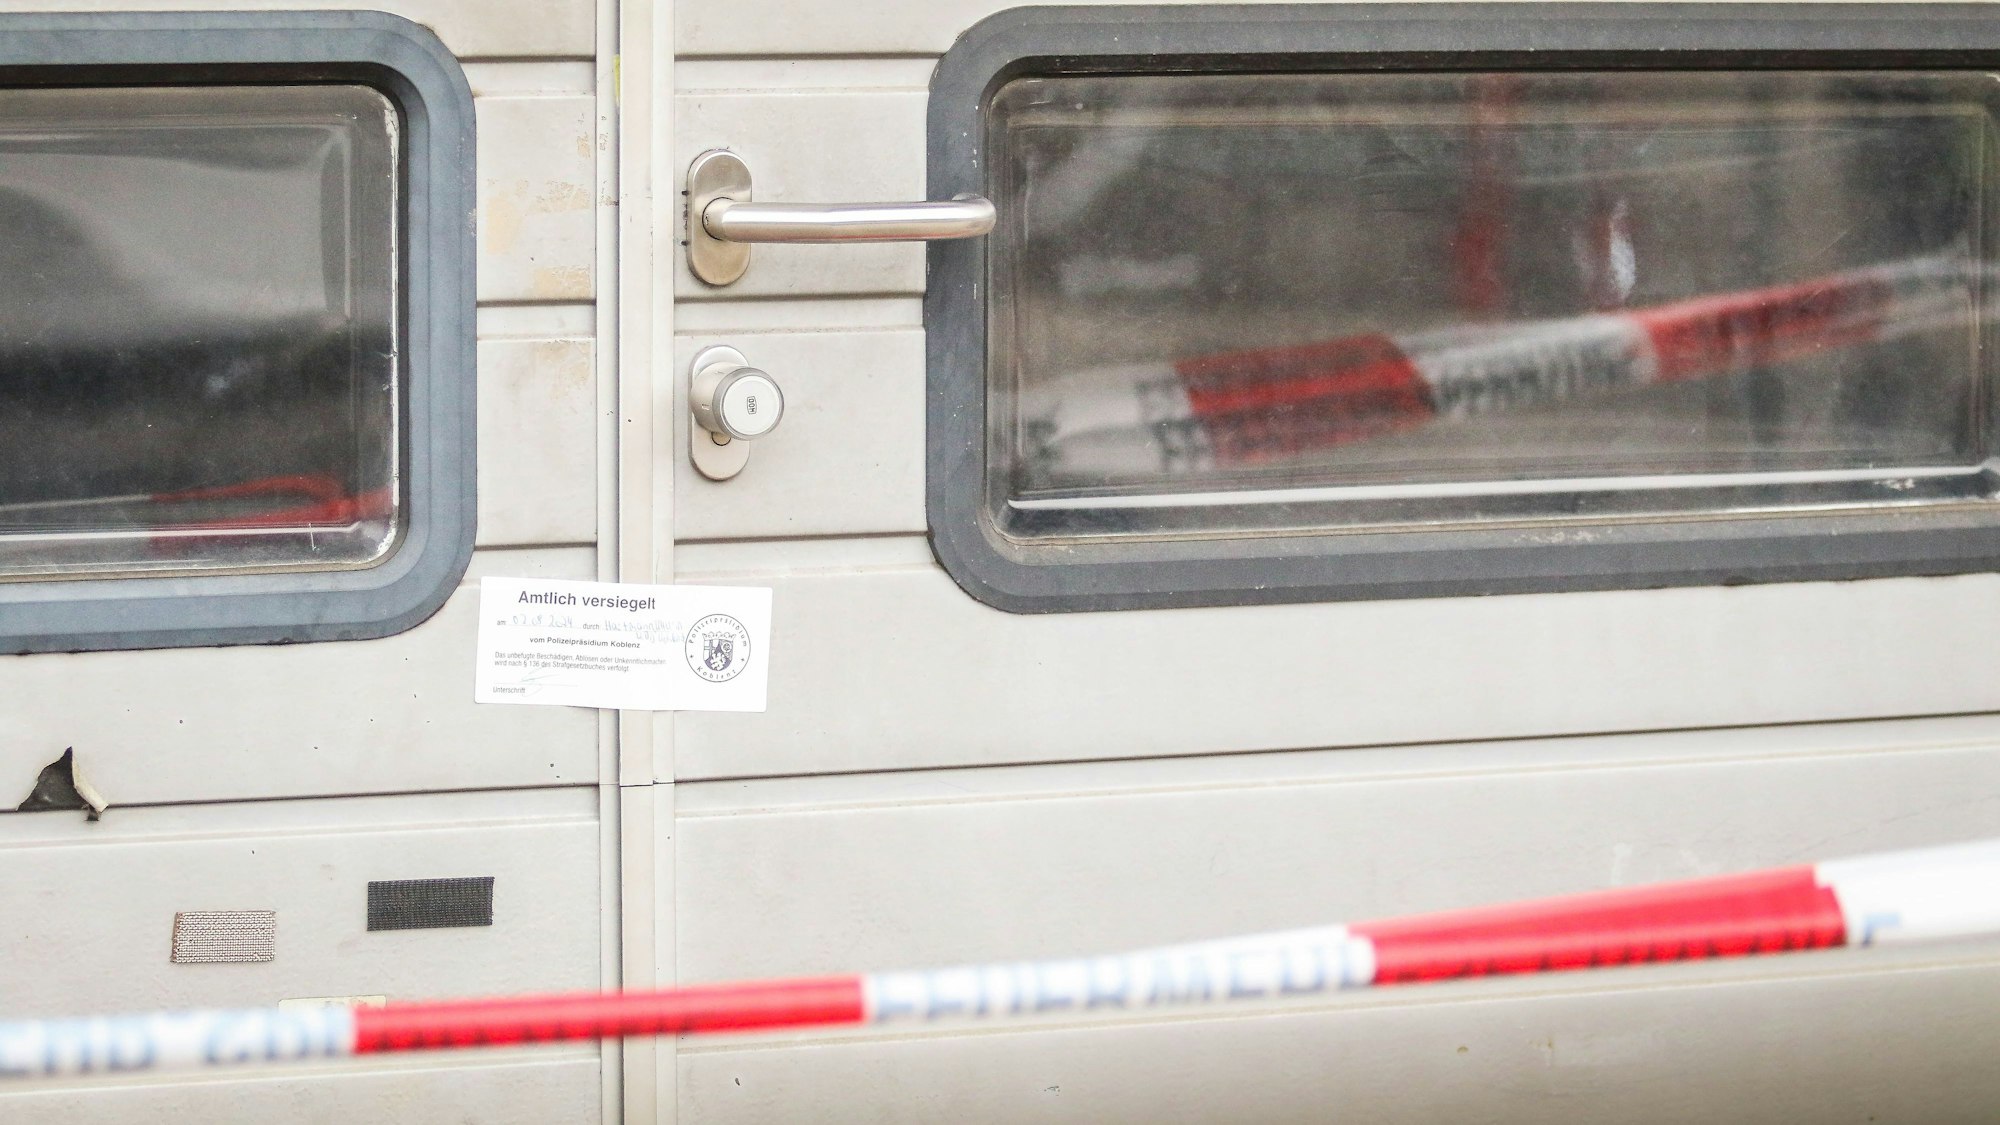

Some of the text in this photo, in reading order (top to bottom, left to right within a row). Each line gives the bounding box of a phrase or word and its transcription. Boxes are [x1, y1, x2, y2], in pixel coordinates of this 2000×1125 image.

[518, 590, 656, 613] Amtlich versiegelt
[582, 622, 600, 630] durch
[547, 636, 609, 648] Polizeipräsidium
[610, 640, 641, 649] Koblenz
[494, 651, 506, 659] Das
[507, 652, 535, 661] unbefugte
[575, 654, 599, 662] Ablösen
[494, 659, 507, 667] wird
[523, 660, 528, 668] §
[529, 660, 540, 668] 136
[552, 661, 606, 671] Strafgesetzbuches
[492, 686, 526, 694] Unterschrift
